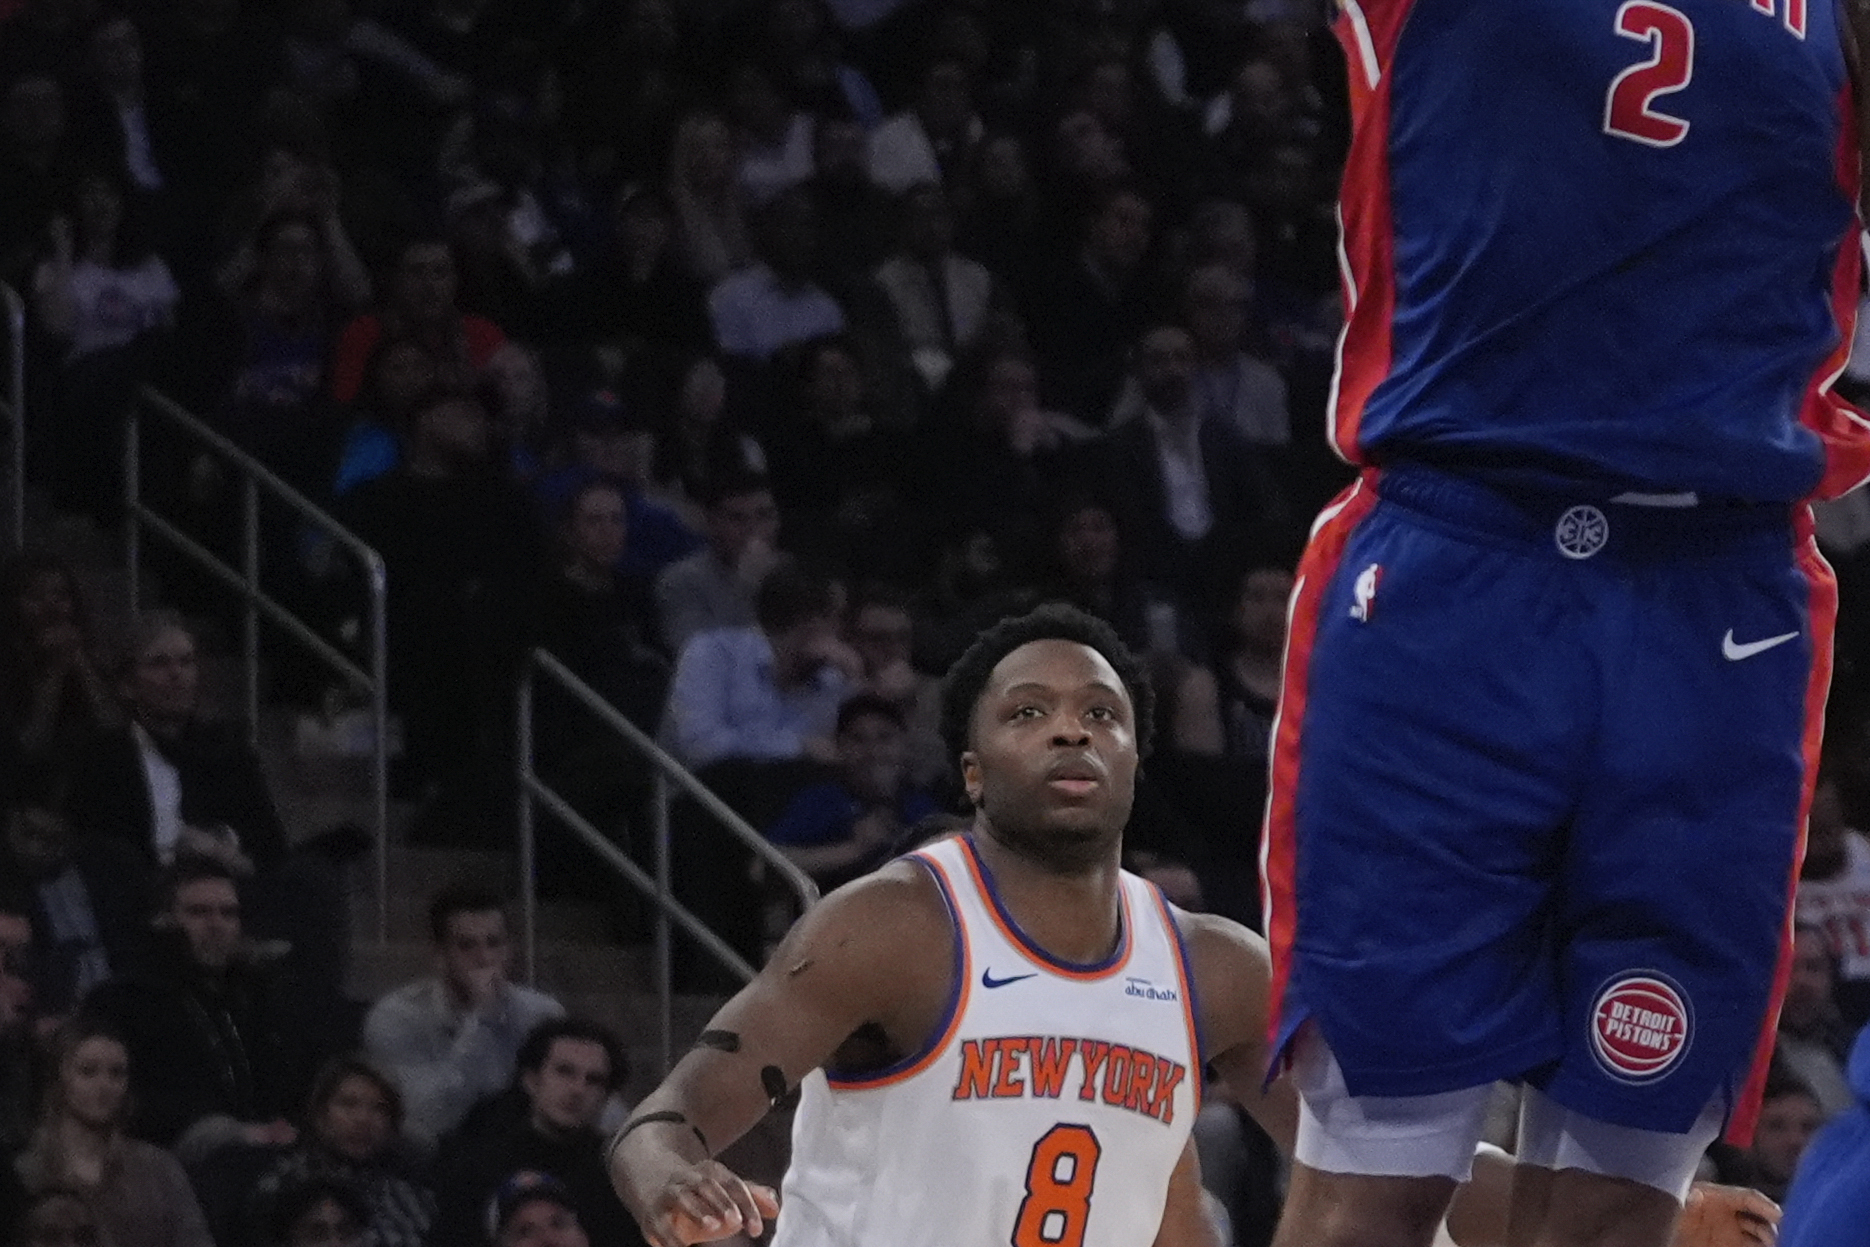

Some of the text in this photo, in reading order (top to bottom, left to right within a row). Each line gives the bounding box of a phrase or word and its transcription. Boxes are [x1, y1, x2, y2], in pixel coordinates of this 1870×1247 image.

[1605, 1017, 1673, 1051] PISTONS
[1611, 999, 1677, 1033] DETROIT
[952, 1036, 1187, 1126] NEW YORK
[1010, 1122, 1102, 1247] 8
